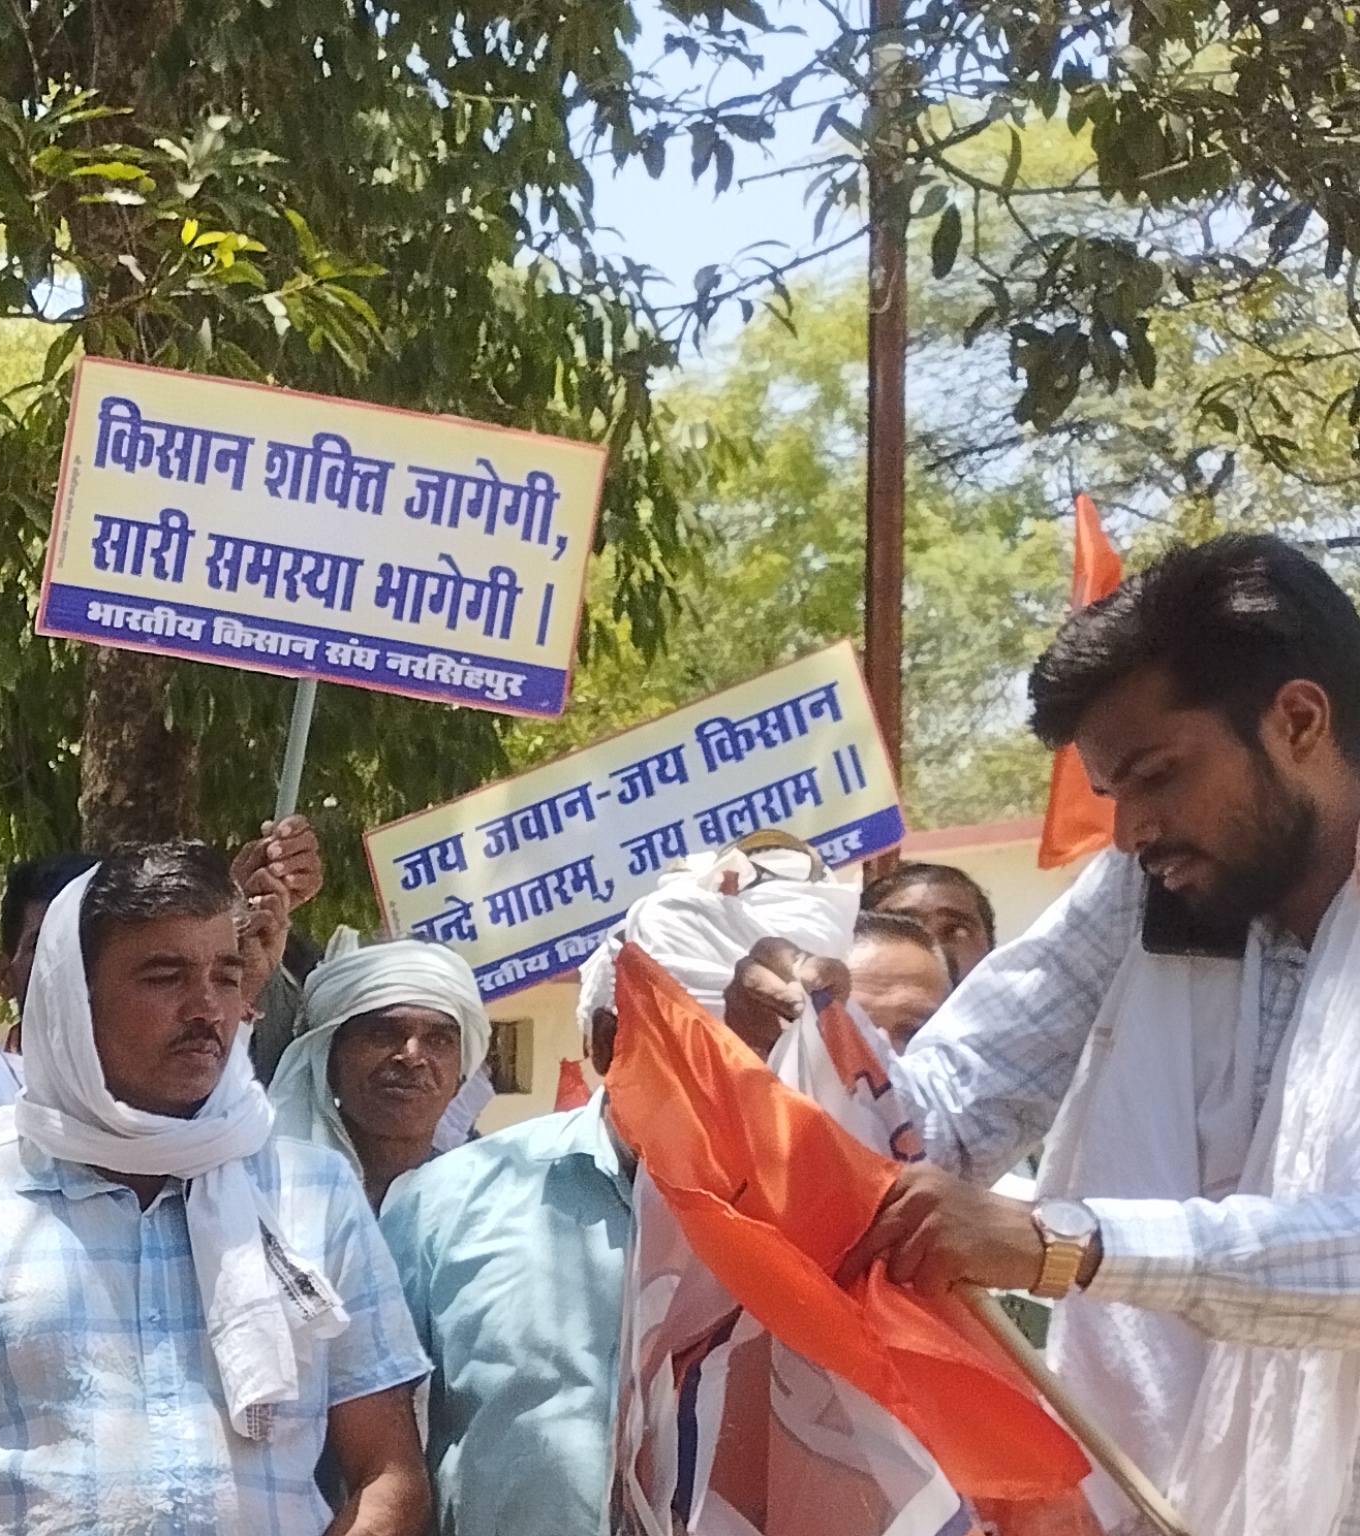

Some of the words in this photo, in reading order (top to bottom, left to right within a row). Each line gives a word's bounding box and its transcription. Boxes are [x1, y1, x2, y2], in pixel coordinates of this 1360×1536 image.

[93, 397, 253, 490] किसान
[265, 432, 396, 515] शक्ति
[404, 458, 569, 560] जागेगी,
[91, 508, 195, 583] सारी
[206, 532, 363, 611] समस्या
[86, 600, 206, 642] भारतीय
[212, 616, 319, 660] किसान
[325, 638, 379, 671] संघ
[386, 651, 527, 701] नरसिंहपुर
[393, 832, 467, 891] जय
[695, 680, 844, 773] किसान
[620, 819, 689, 877] जय
[693, 766, 824, 846] बलराम
